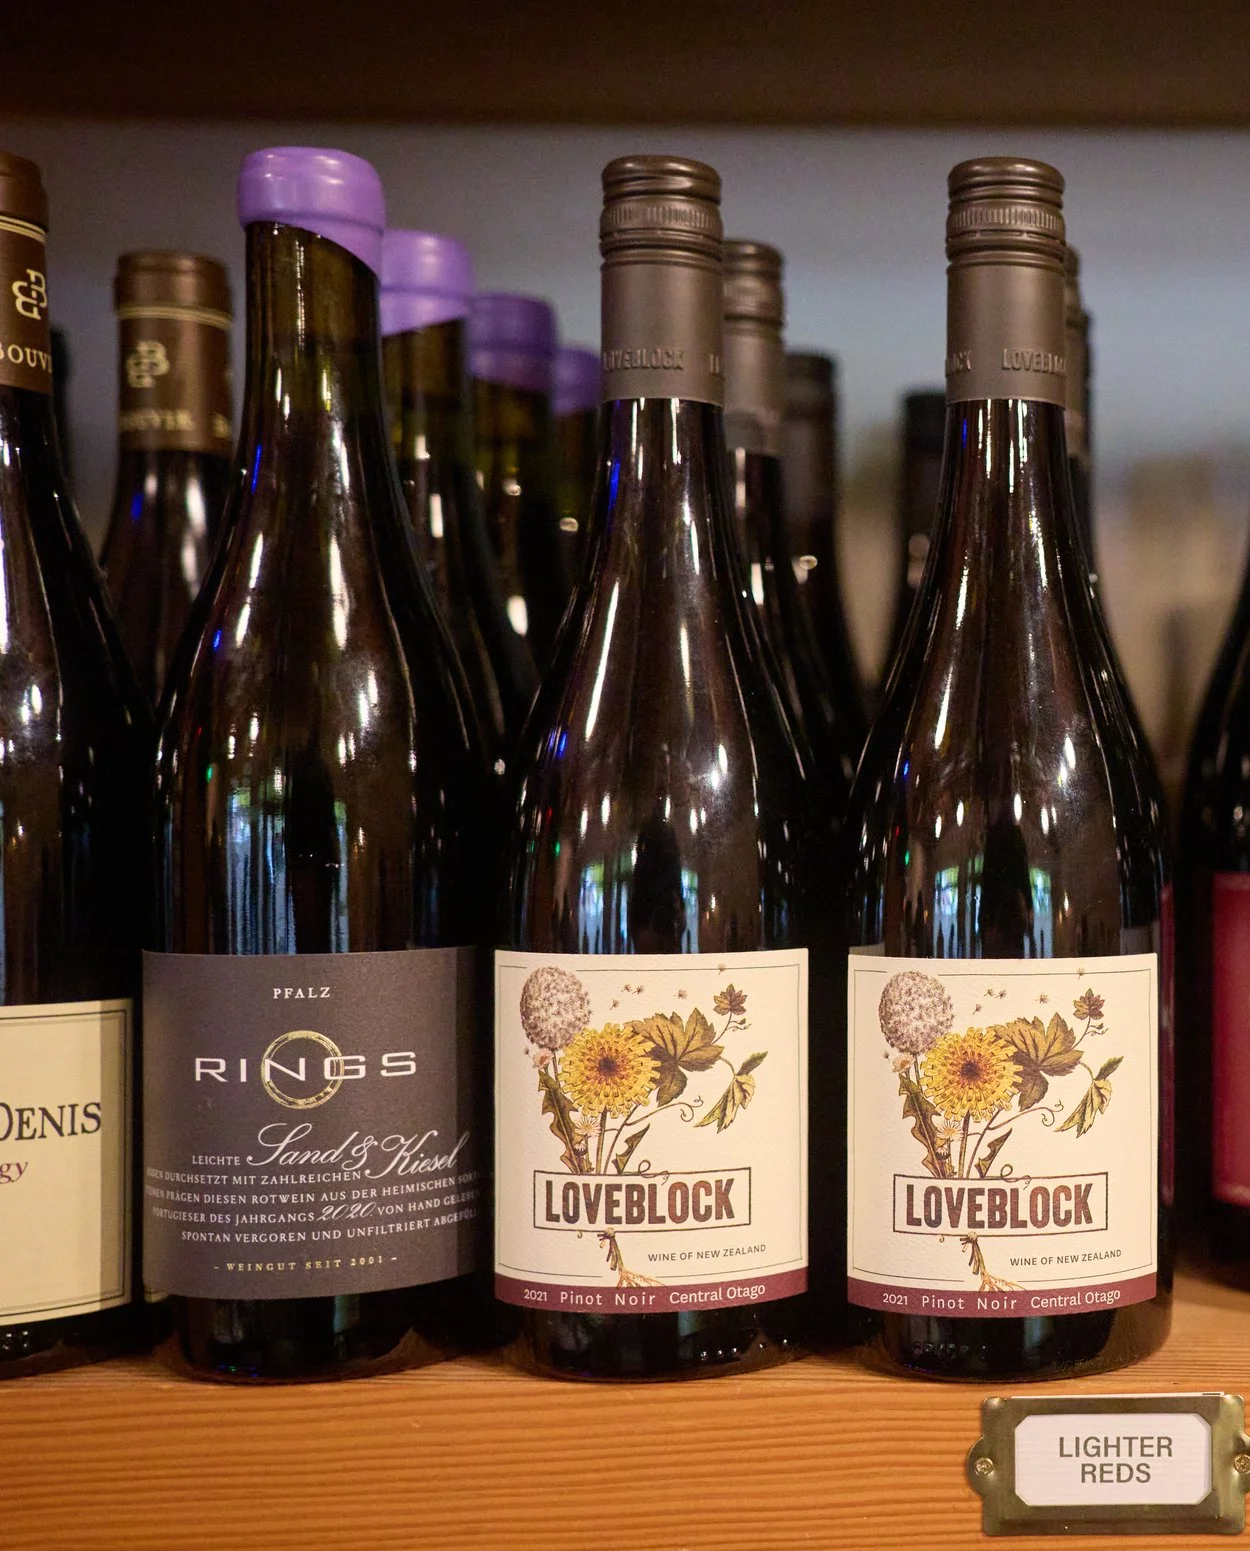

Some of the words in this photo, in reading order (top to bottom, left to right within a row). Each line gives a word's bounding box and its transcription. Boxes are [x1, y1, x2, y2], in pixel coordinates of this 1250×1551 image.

[273, 986, 332, 999] PFALZ
[195, 1051, 417, 1083] RINGS
[192, 1155, 241, 1166] LEICHTE
[246, 1123, 360, 1166] Sand
[341, 1135, 379, 1171] &
[364, 1130, 470, 1179] Kiesel
[164, 1171, 229, 1185] DURCHSETZT
[232, 1175, 257, 1185] MIT
[260, 1171, 362, 1185] ZAHLREICHEN
[203, 1194, 247, 1204] DIESEN
[251, 1193, 315, 1204] ROTWEIN
[320, 1191, 346, 1201] AUS
[352, 1188, 378, 1199] DER
[382, 1176, 456, 1197] HEIMISCHEN
[210, 1213, 231, 1223] DES
[235, 1212, 315, 1226] JAHRGANGS
[378, 1204, 404, 1215] VON
[408, 1198, 441, 1212] HAND
[545, 1178, 735, 1225] LOVEBLOCK
[905, 1183, 1093, 1229] LOVEBLOCK
[181, 1231, 231, 1243] SPONTAN
[234, 1231, 307, 1243] VERGOREN
[311, 1230, 342, 1240] UND
[347, 1218, 431, 1238] UNFILTRIERT
[226, 1262, 297, 1272] WEINGUT
[305, 1259, 341, 1269] SEIT
[350, 1255, 383, 1267] 2001
[647, 1252, 677, 1262] WINE
[679, 1250, 694, 1260] OF
[696, 1249, 721, 1259] NEW
[723, 1244, 767, 1258] ZEALAND
[1010, 1257, 1038, 1266] WINE
[1040, 1256, 1054, 1265] OF
[1056, 1254, 1080, 1264] NEW
[1081, 1249, 1122, 1262] ZEALAND
[523, 1288, 548, 1302] 2021
[560, 1291, 603, 1306] Pinot
[615, 1292, 656, 1306] Noir
[669, 1287, 723, 1304] Central
[726, 1284, 766, 1301] Otago
[882, 1292, 908, 1306] 2021
[921, 1294, 965, 1310] Pinot
[977, 1297, 1017, 1310] Noir
[1030, 1292, 1082, 1308] Central
[1085, 1288, 1121, 1305] Otago
[1059, 1436, 1173, 1458] LIGHTER
[1080, 1463, 1151, 1484] REDS
